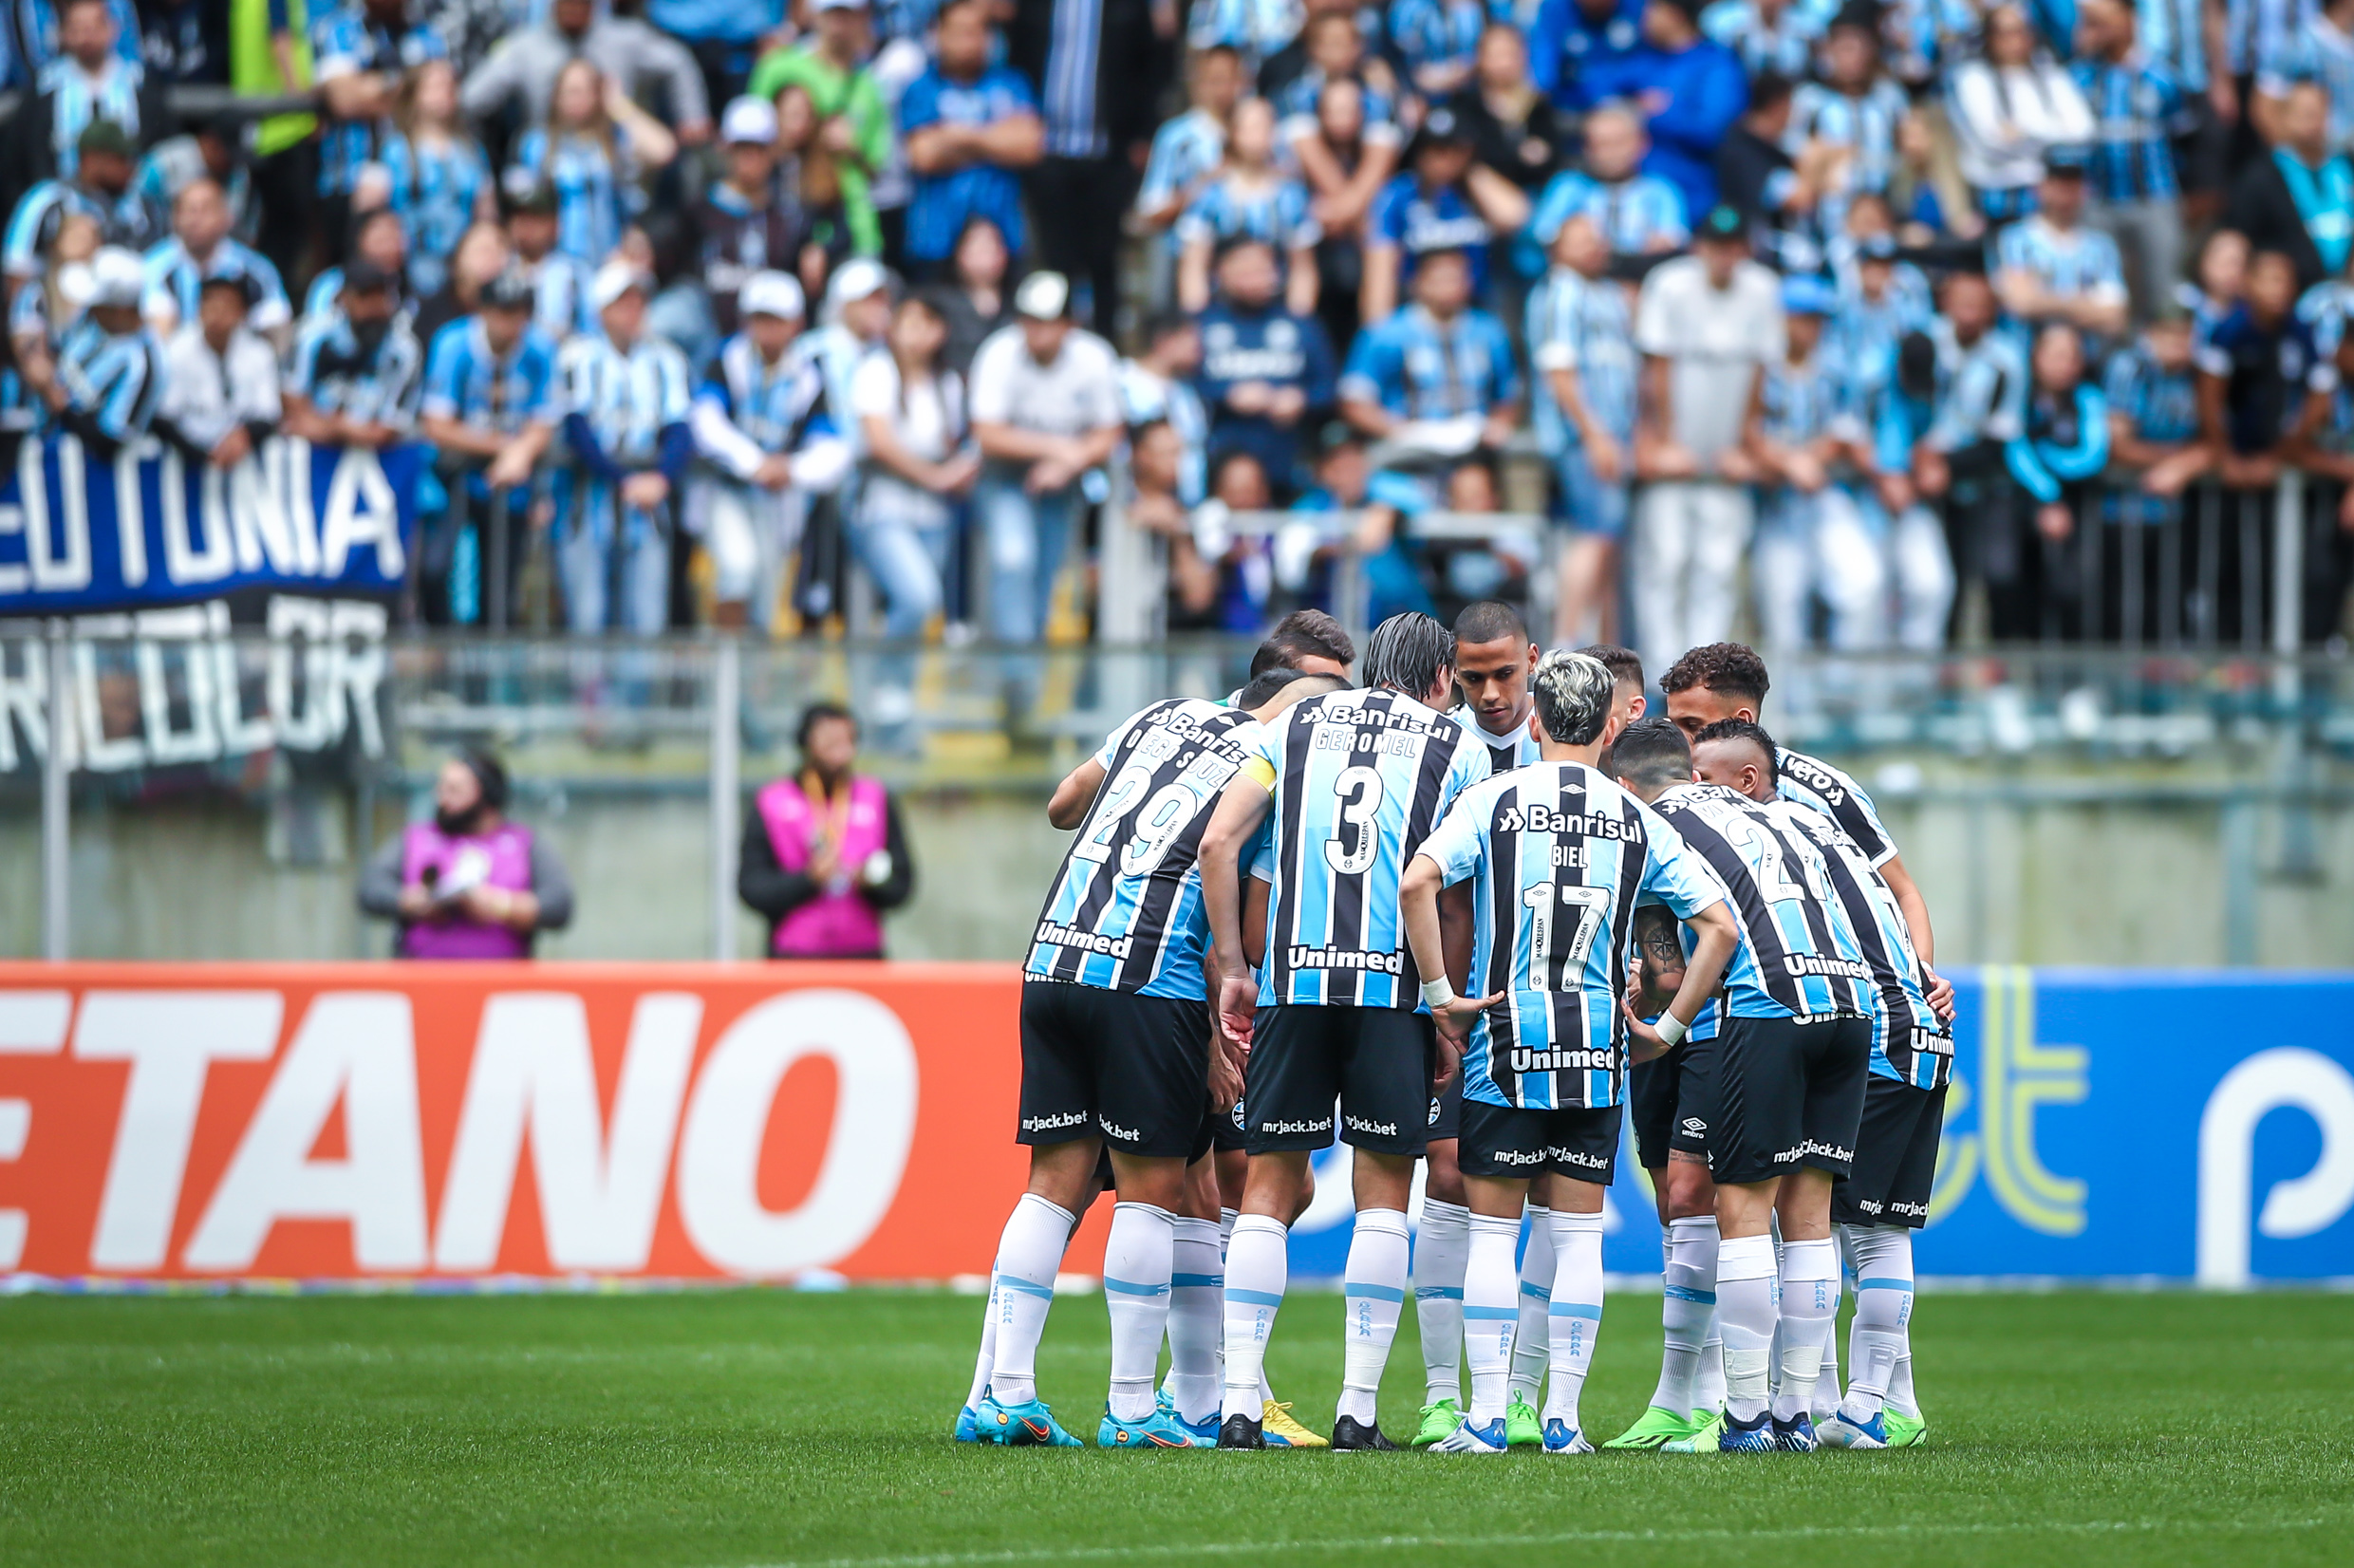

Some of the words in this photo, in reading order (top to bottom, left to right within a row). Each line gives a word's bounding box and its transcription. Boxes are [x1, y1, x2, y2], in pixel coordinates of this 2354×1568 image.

[1328, 706, 1451, 741] Banrisul
[1167, 713, 1247, 768] Banris
[1316, 729, 1415, 758] GEROMEL
[1126, 729, 1181, 762] DIEGO
[1176, 751, 1232, 793] SOUZ
[1787, 757, 1833, 791] vero
[1074, 766, 1197, 876] 29
[1324, 765, 1384, 875] 3
[1528, 805, 1642, 844] Banrisul
[1552, 845, 1588, 868] BIEL
[1037, 924, 1133, 960] Unimed
[1523, 881, 1611, 993] 17
[1536, 918, 1544, 959] MARQUESPAN
[1288, 944, 1405, 975] Unimed
[1510, 1044, 1614, 1071] Unimed
[1910, 1027, 1954, 1056] Unim
[1022, 1110, 1089, 1131] mrJack.bet
[1261, 1116, 1332, 1134] mrJack.bet
[1681, 1129, 1705, 1139] umbro
[1547, 1145, 1609, 1170] mrJack.bet
[1803, 1138, 1855, 1163] rJack.bet
